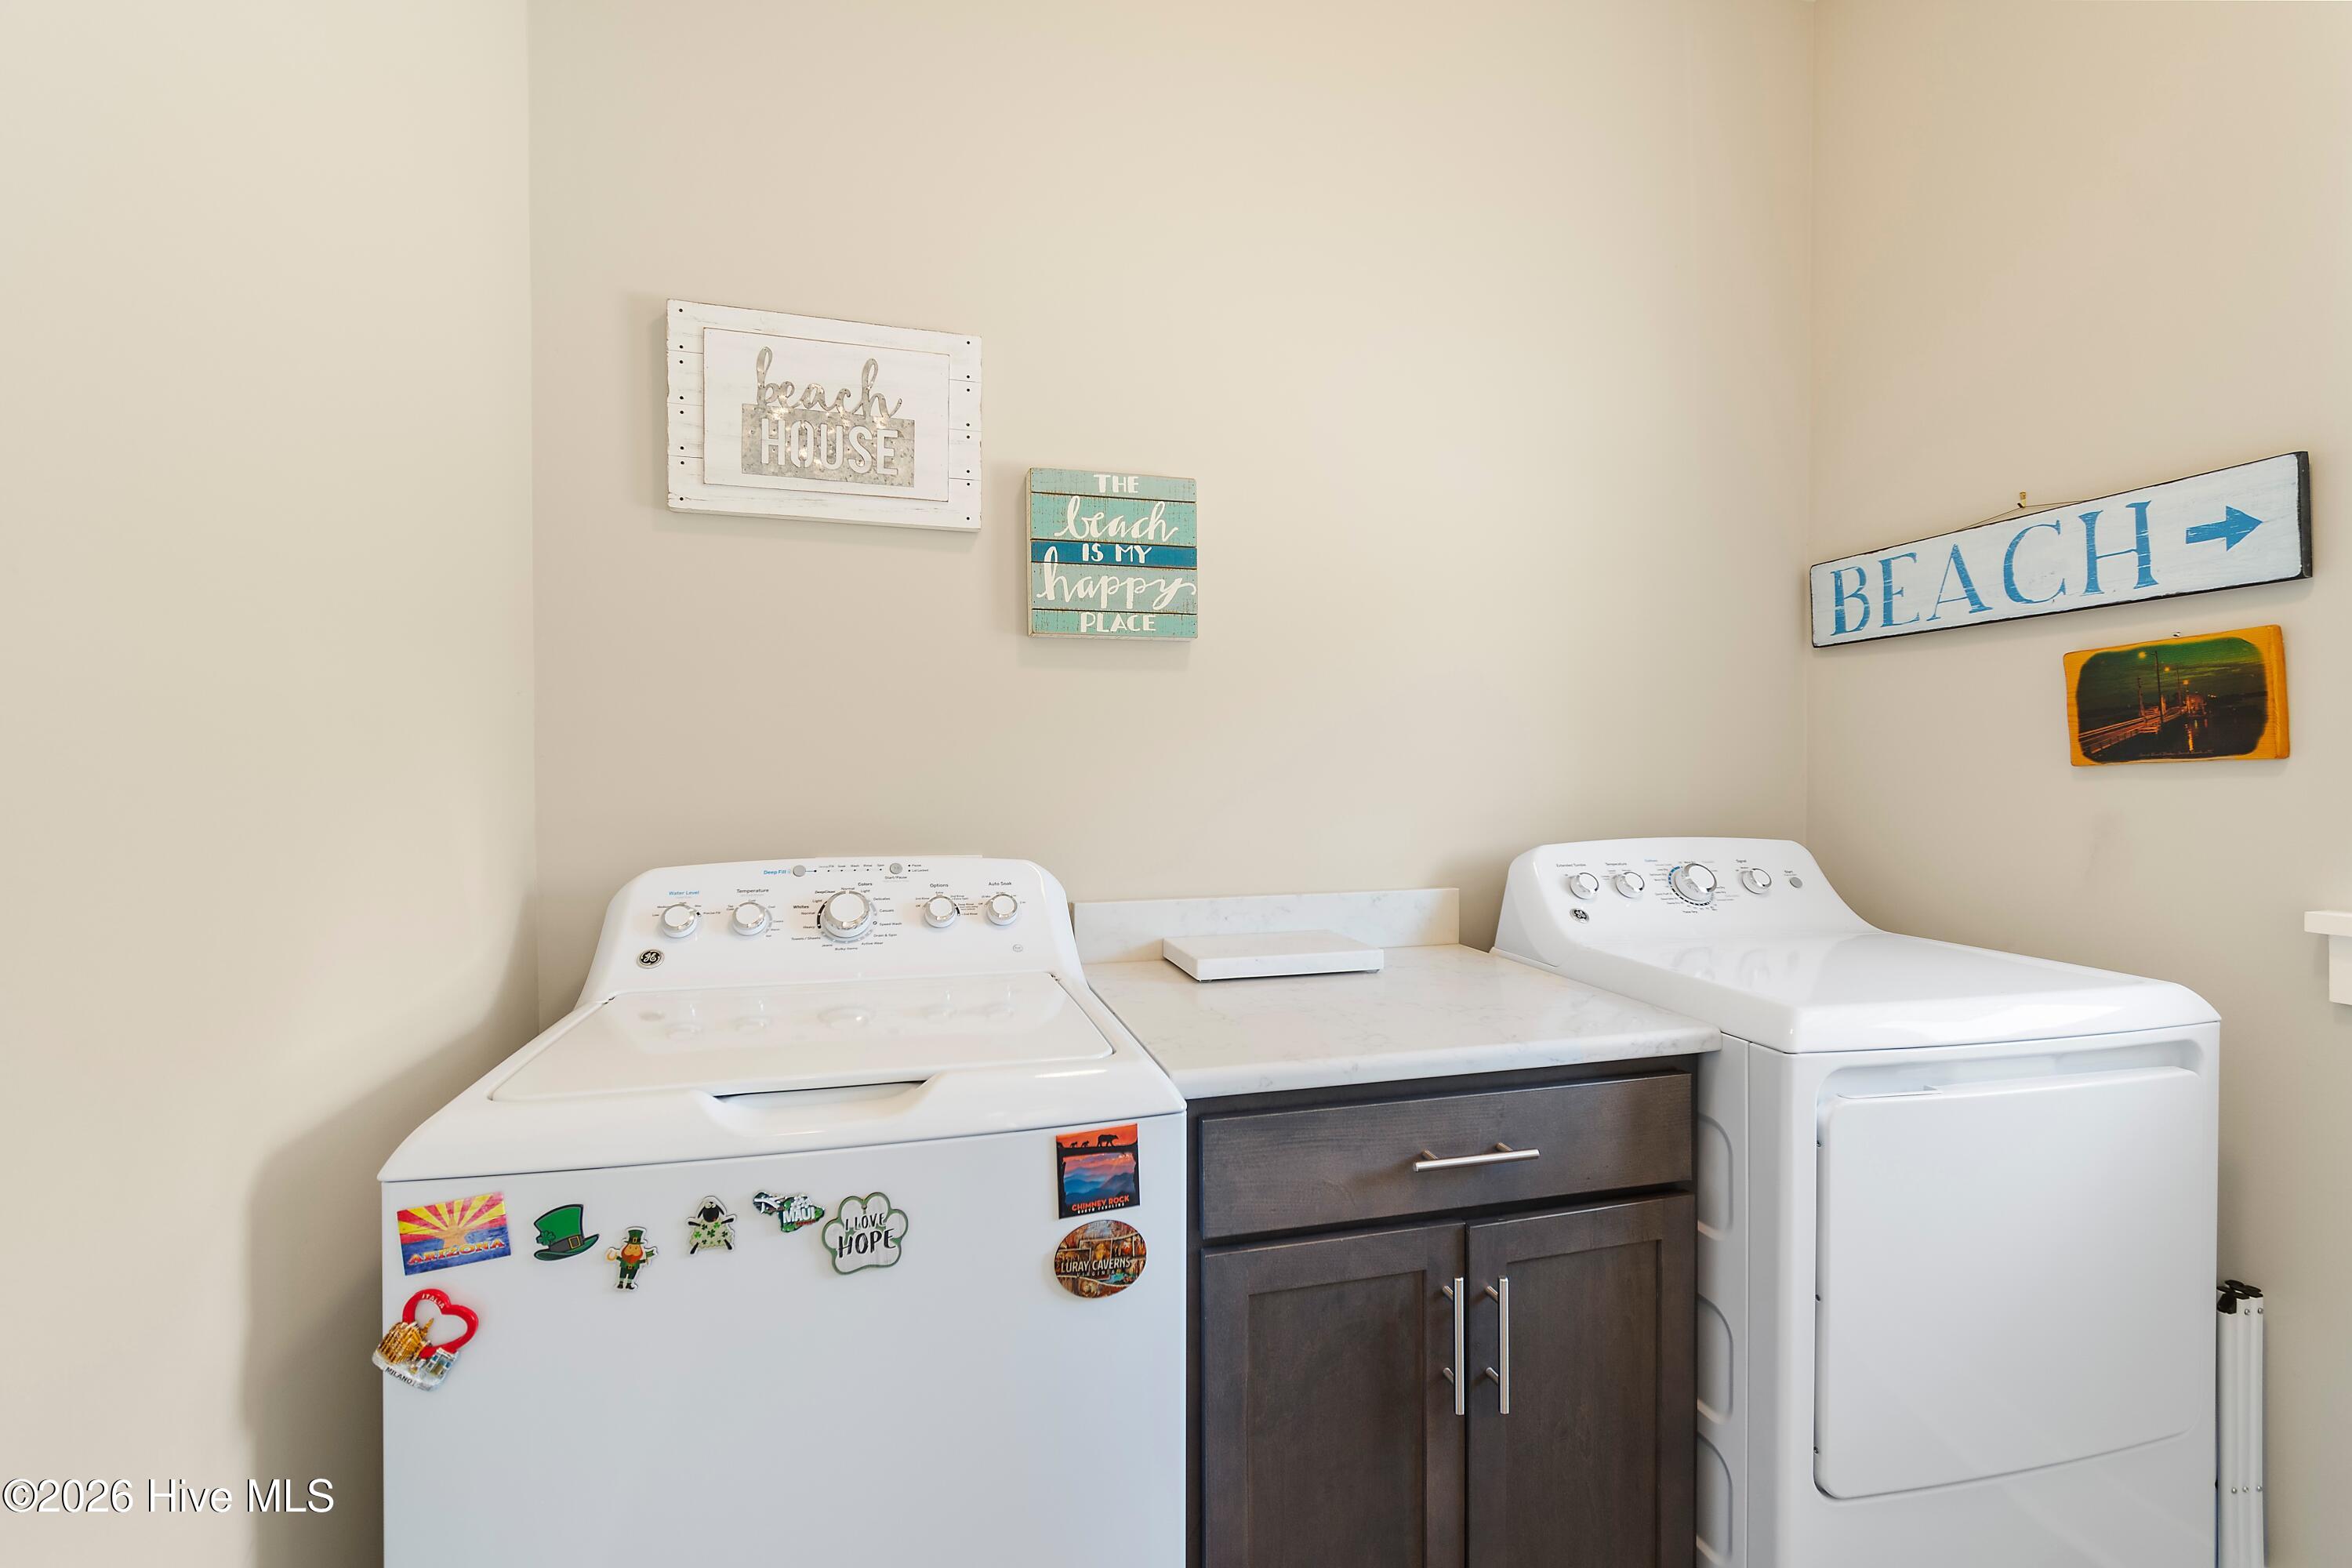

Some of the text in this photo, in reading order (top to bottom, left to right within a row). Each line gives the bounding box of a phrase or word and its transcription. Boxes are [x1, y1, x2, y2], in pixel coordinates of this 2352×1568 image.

[756, 346, 902, 419] beach
[761, 418, 898, 475] HOUSE
[1094, 474, 1138, 494] THE
[1054, 495, 1178, 542] beach
[1082, 543, 1152, 564] IS MY
[1830, 499, 2160, 636] BEACH
[1036, 546, 1197, 612] happy
[1080, 612, 1157, 633] PLACE
[1072, 1195, 1130, 1211] CHIMNEY ROCK
[782, 1207, 815, 1223] MAUI
[844, 1212, 884, 1231] I LOVE
[407, 1237, 506, 1265] ARIZONA
[837, 1228, 897, 1258] HOPE
[1061, 1257, 1131, 1273] LURAY CAVERNS
[421, 1293, 445, 1309] ITALIA
[385, 1367, 413, 1385] MILANO
